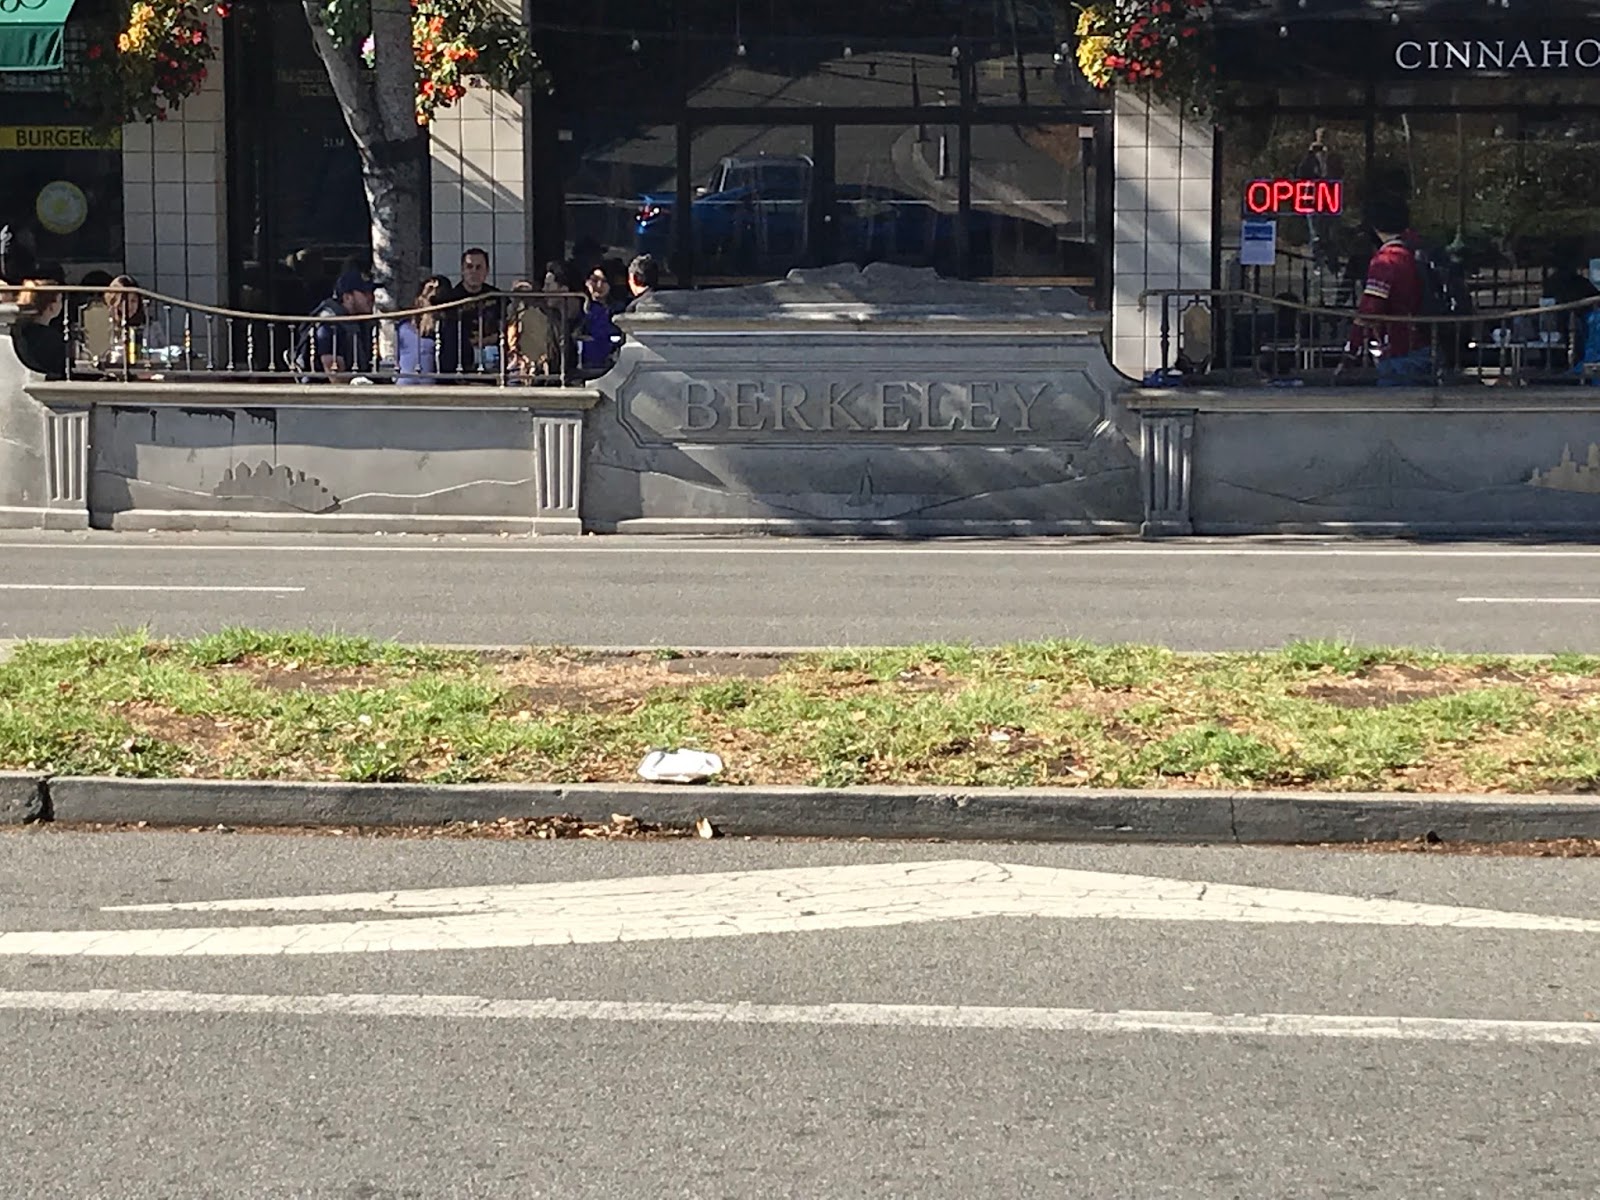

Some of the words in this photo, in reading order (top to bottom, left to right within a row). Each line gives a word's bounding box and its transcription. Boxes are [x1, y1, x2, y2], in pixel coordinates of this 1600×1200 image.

[1395, 39, 1600, 69] CINNAHO
[16, 129, 100, 147] BURGER
[1248, 180, 1340, 213] OPEN
[682, 381, 1051, 432] BERKELEY
